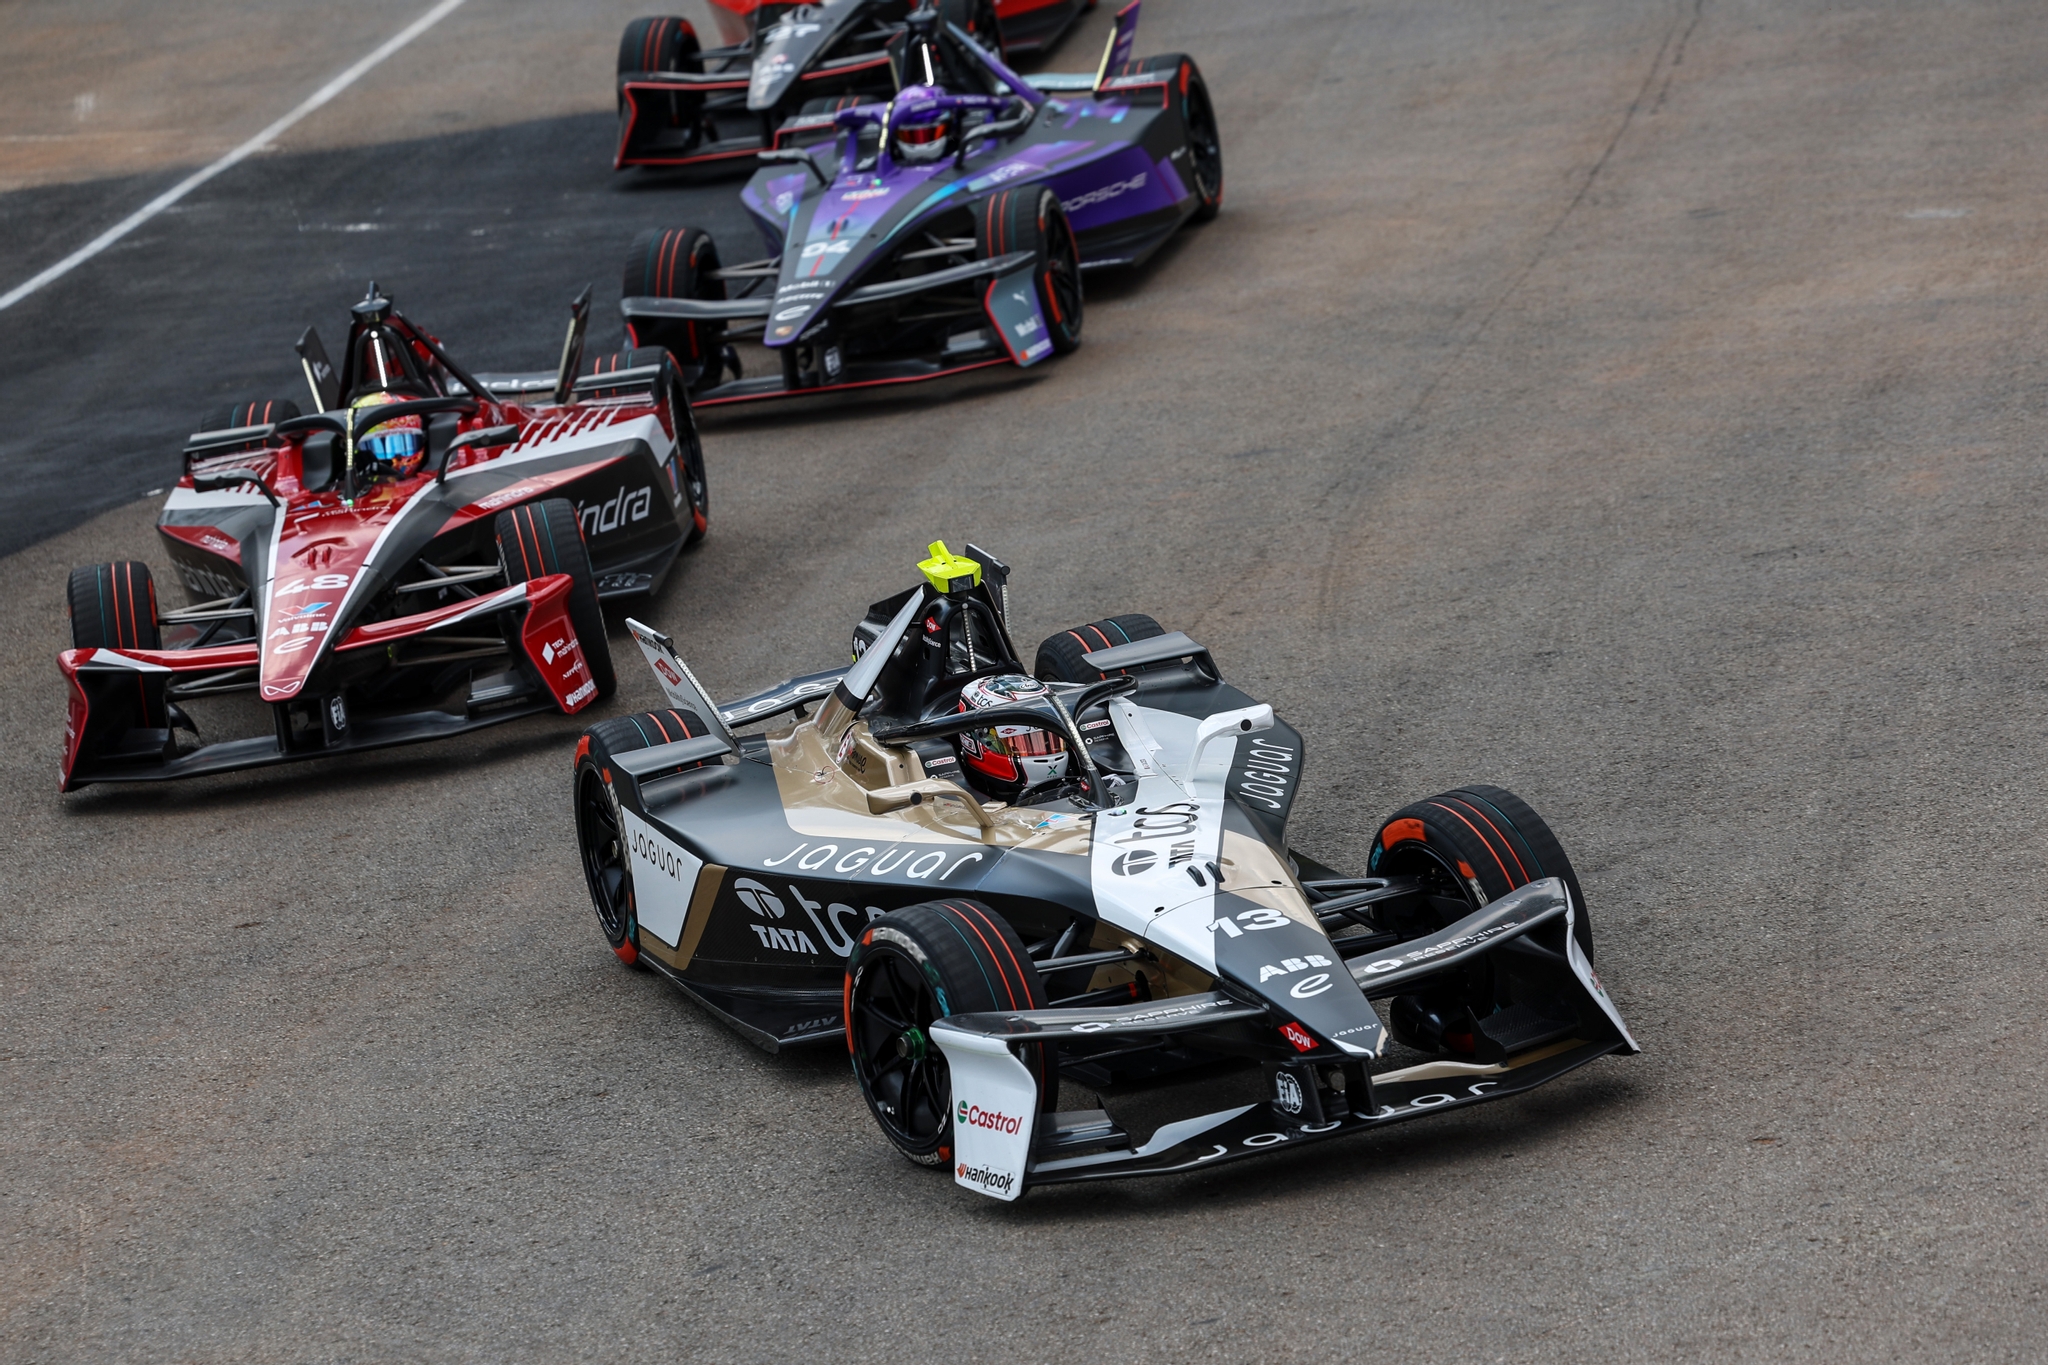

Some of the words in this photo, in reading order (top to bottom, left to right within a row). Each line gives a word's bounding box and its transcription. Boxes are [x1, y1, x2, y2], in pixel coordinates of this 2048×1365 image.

[801, 239, 851, 258] 94
[578, 486, 652, 536] indra
[274, 573, 350, 598] 48
[277, 612, 326, 624] Valvoline
[267, 621, 329, 641] ABB
[1086, 720, 1110, 729] Castrol
[931, 757, 956, 766] Castrol
[1206, 907, 1291, 939] 13
[749, 923, 820, 955] TATA
[1406, 921, 1520, 958] SAPPHIRE
[1413, 935, 1489, 961] RESERVE
[1259, 954, 1333, 984] ABB
[1116, 999, 1234, 1023] SAPPHIRE
[1121, 1010, 1201, 1027] RESERVE
[968, 1104, 1023, 1136] Castrol
